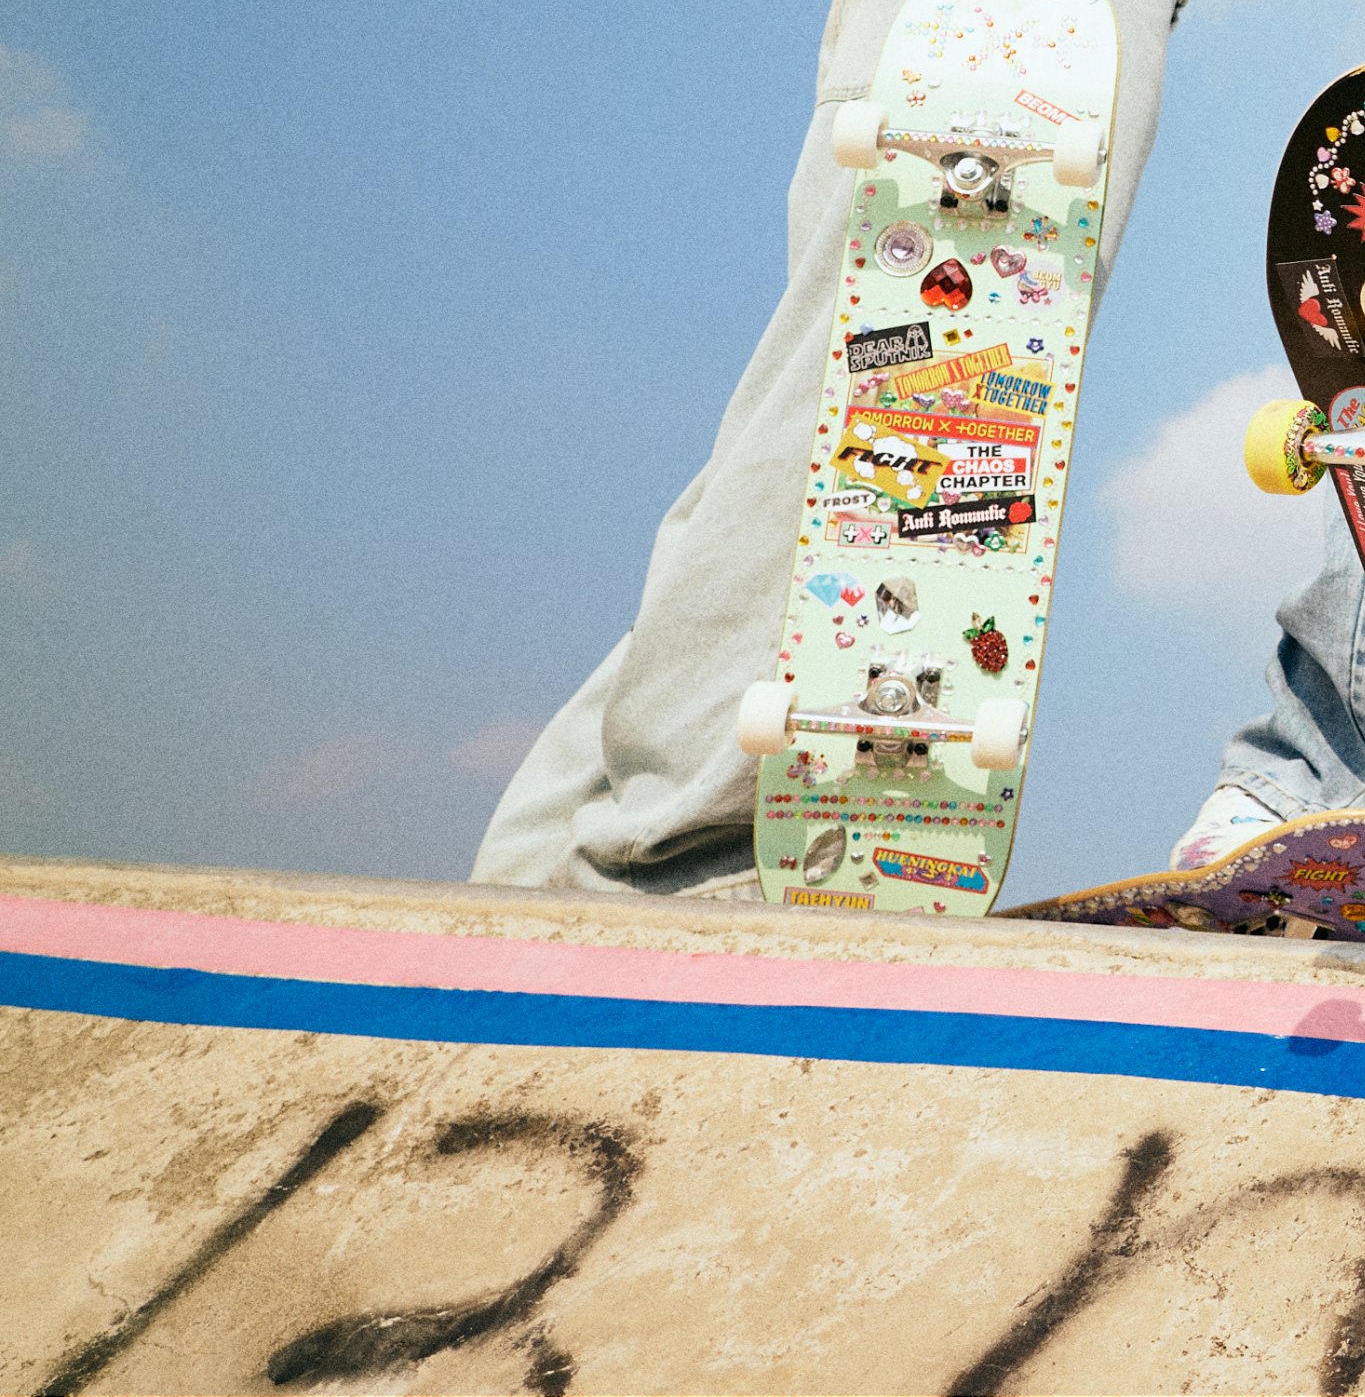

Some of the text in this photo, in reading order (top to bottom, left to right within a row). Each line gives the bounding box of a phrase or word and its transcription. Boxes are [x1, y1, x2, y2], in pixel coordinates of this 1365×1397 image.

[1315, 264, 1360, 354] Anti Romantic
[848, 336, 905, 357] DEAR
[850, 346, 931, 372] SPUTNIK
[897, 365, 950, 399] TOMORROW
[959, 346, 1012, 377] TOGETHER
[980, 371, 1052, 399] TOMORROW
[984, 387, 1048, 415] TOGETHER
[1337, 398, 1360, 429] The
[837, 446, 942, 475] FIGHT
[967, 445, 1002, 458] THE
[952, 458, 1015, 474] CHAOS
[940, 474, 1026, 489] CHAPTER
[823, 494, 871, 508] FROST
[901, 505, 1007, 532] Anti Romantic
[876, 850, 977, 879] HUENINGKAI
[1294, 868, 1349, 883] FIGHT
[789, 890, 870, 909] TAEHYUN
